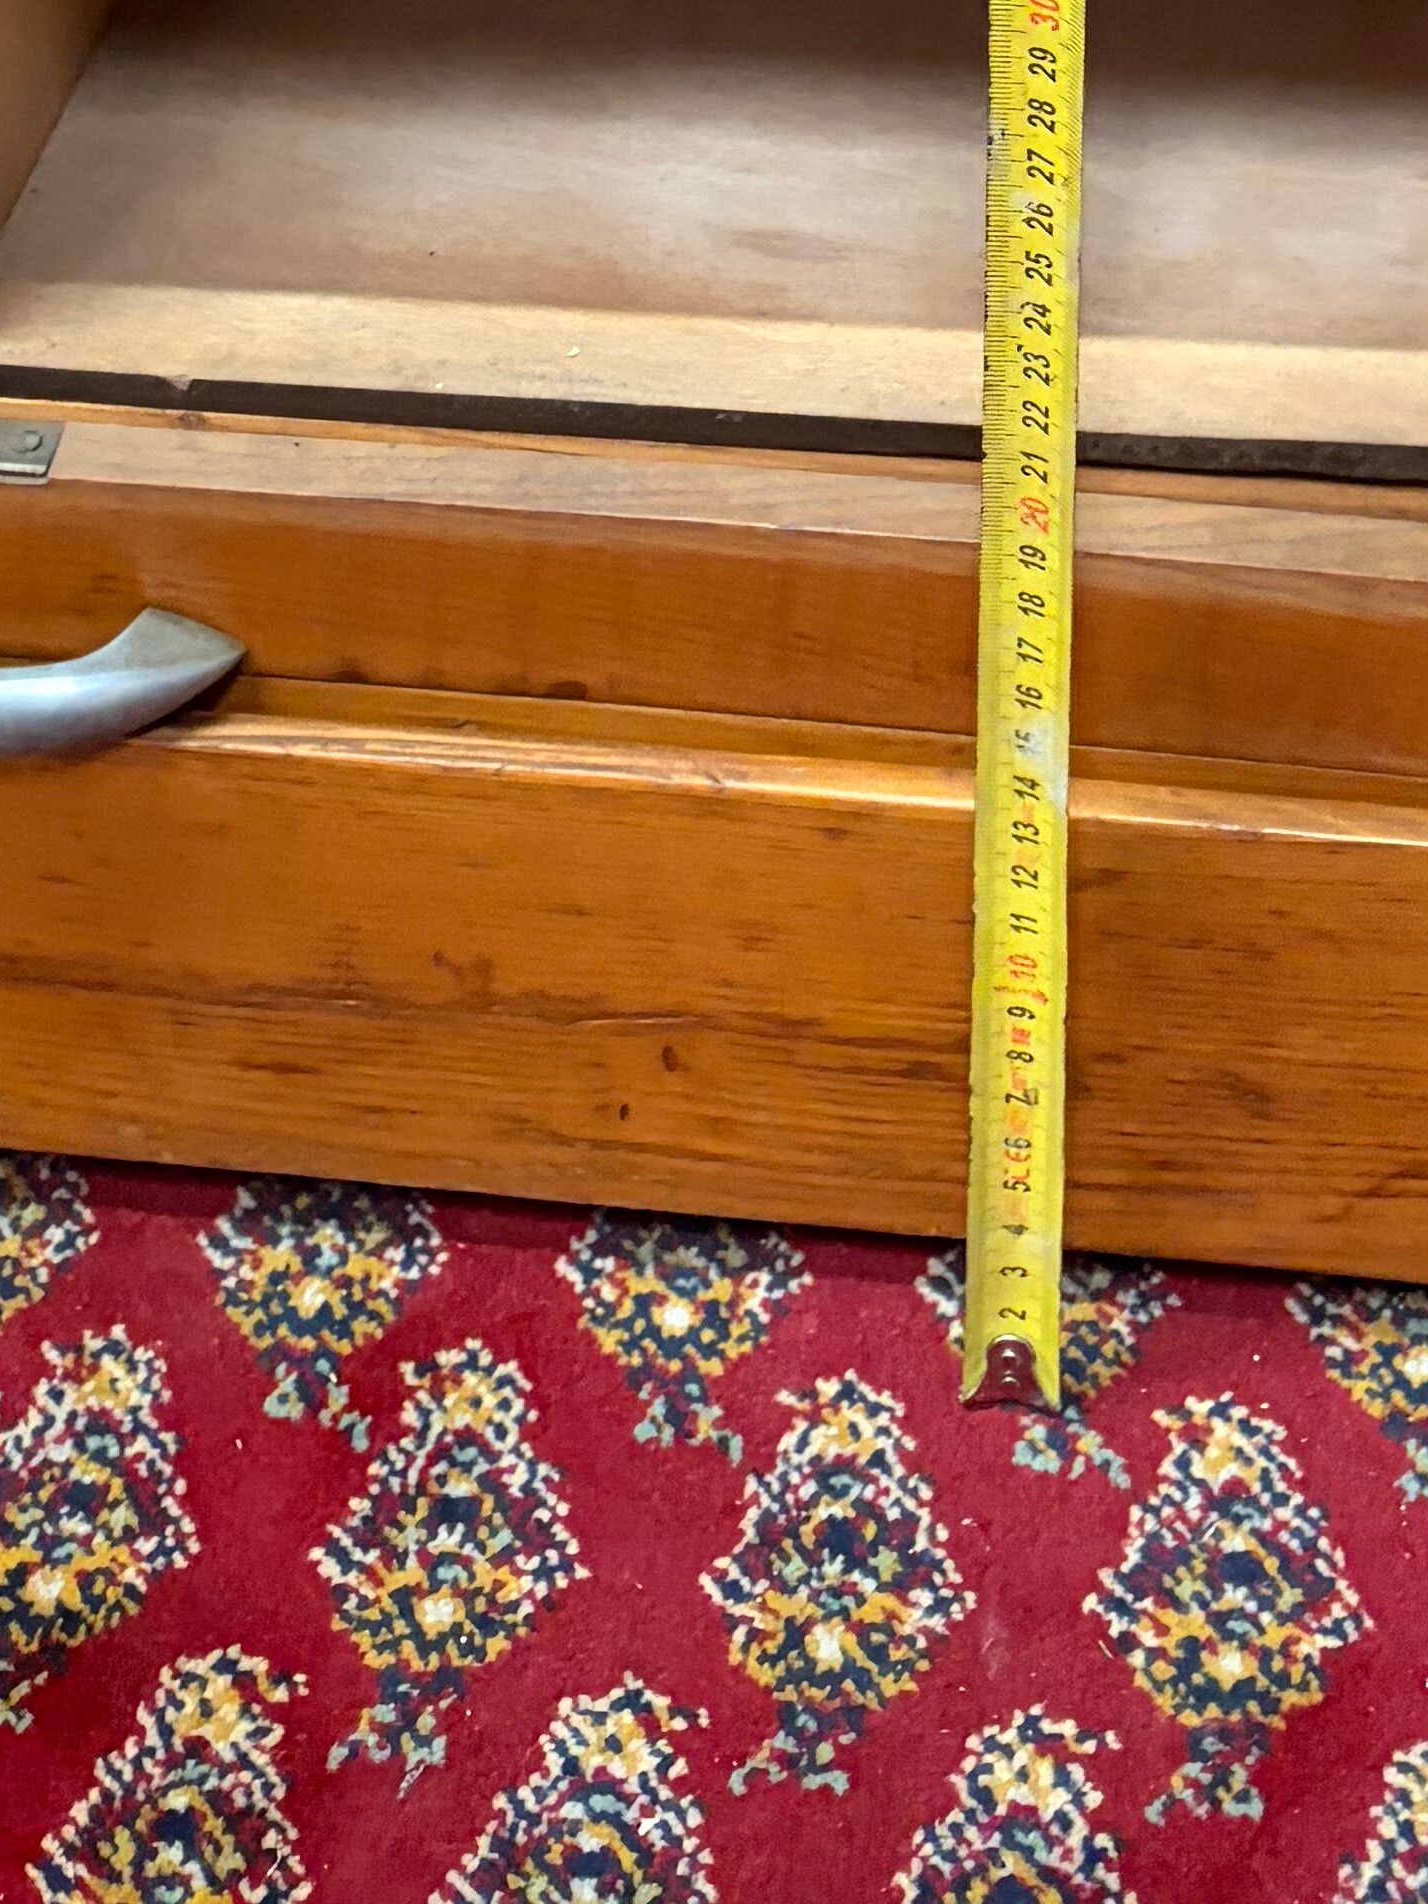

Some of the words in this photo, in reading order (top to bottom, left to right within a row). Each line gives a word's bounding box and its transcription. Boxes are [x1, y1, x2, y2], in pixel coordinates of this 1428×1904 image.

[1028, 47, 1056, 82] 29
[1027, 98, 1056, 133] 28
[1026, 149, 1054, 185] 27
[1022, 202, 1053, 236] 26
[1025, 251, 1053, 286] 25
[1020, 302, 1051, 335] 24
[1023, 352, 1054, 386] 23
[1022, 400, 1049, 435] 22
[1020, 451, 1048, 484] 21
[1020, 497, 1049, 534] 20
[1018, 545, 1046, 570] 19
[1018, 591, 1045, 617] 18
[1016, 637, 1043, 663] 17
[1015, 684, 1042, 709] 16
[1012, 774, 1042, 801] 14
[1011, 819, 1041, 845] 13
[1010, 864, 1040, 890] 12
[1009, 912, 1039, 935] 11
[1008, 954, 1038, 984] 10
[1007, 1006, 1036, 1020] 9
[1006, 1049, 1035, 1064] 8
[1004, 1137, 1032, 1149] 6
[1003, 1179, 1031, 1193] 5
[999, 1265, 1028, 1278] 3
[998, 1306, 1027, 1321] 2
